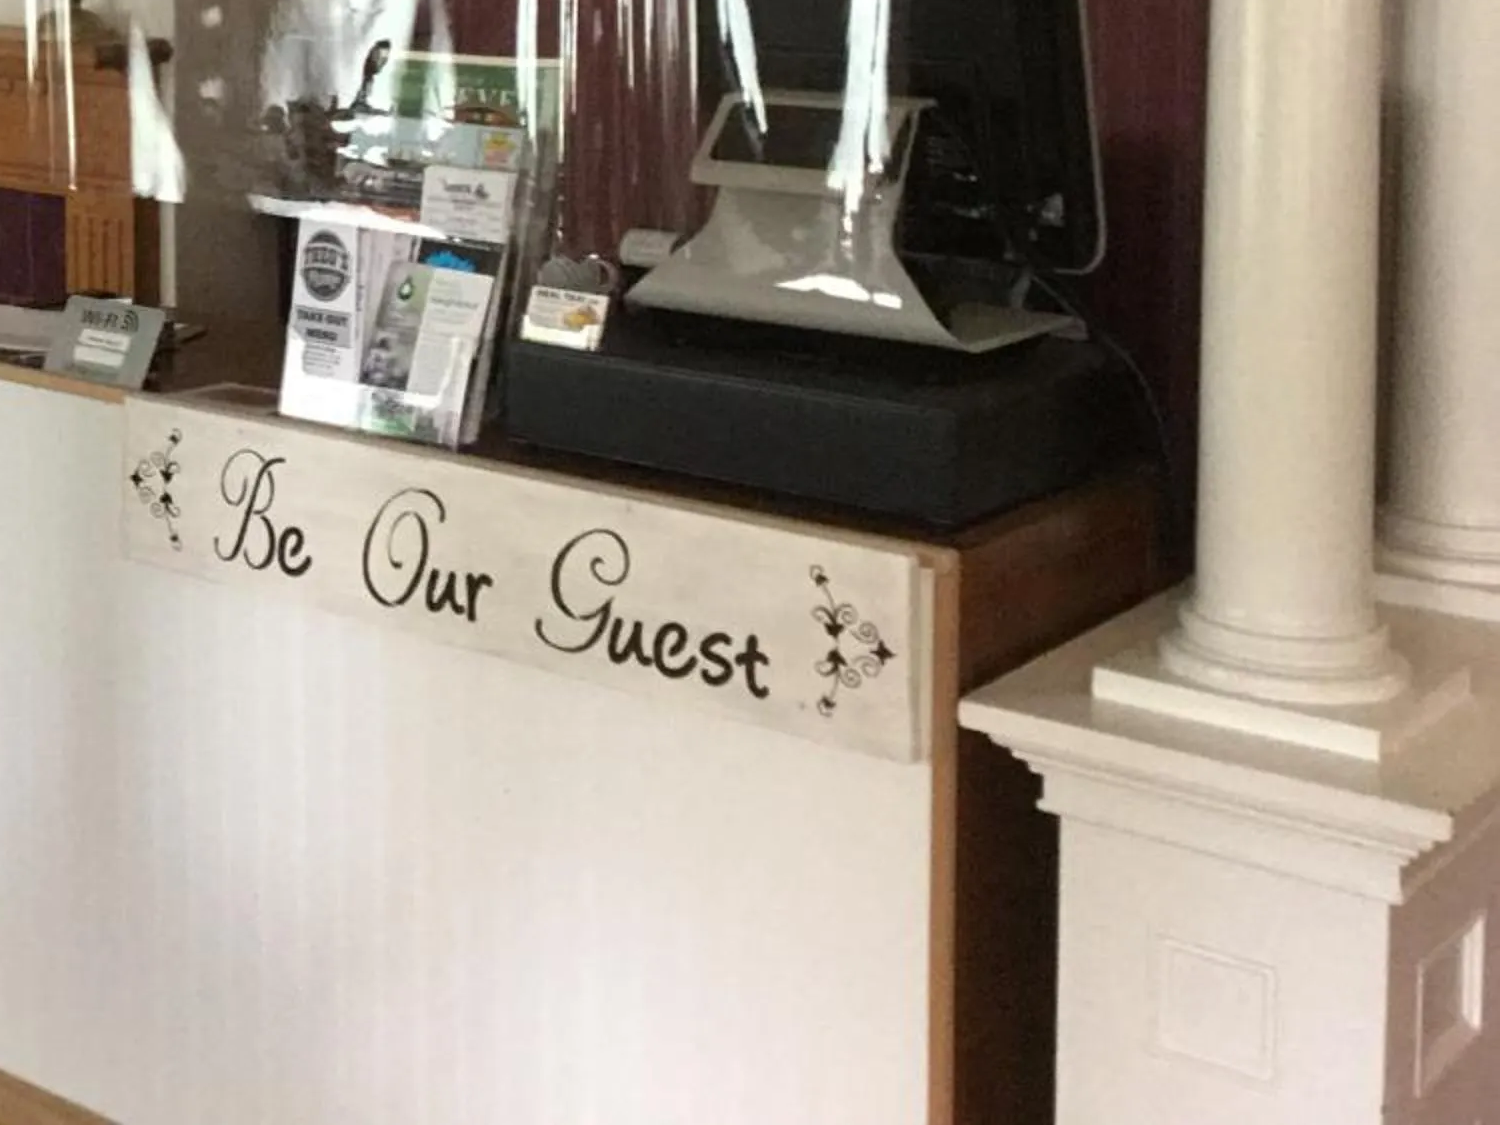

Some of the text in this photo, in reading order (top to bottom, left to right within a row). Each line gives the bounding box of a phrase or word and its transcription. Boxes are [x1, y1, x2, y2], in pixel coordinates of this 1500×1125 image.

[213, 448, 770, 700] Be Our Guest
